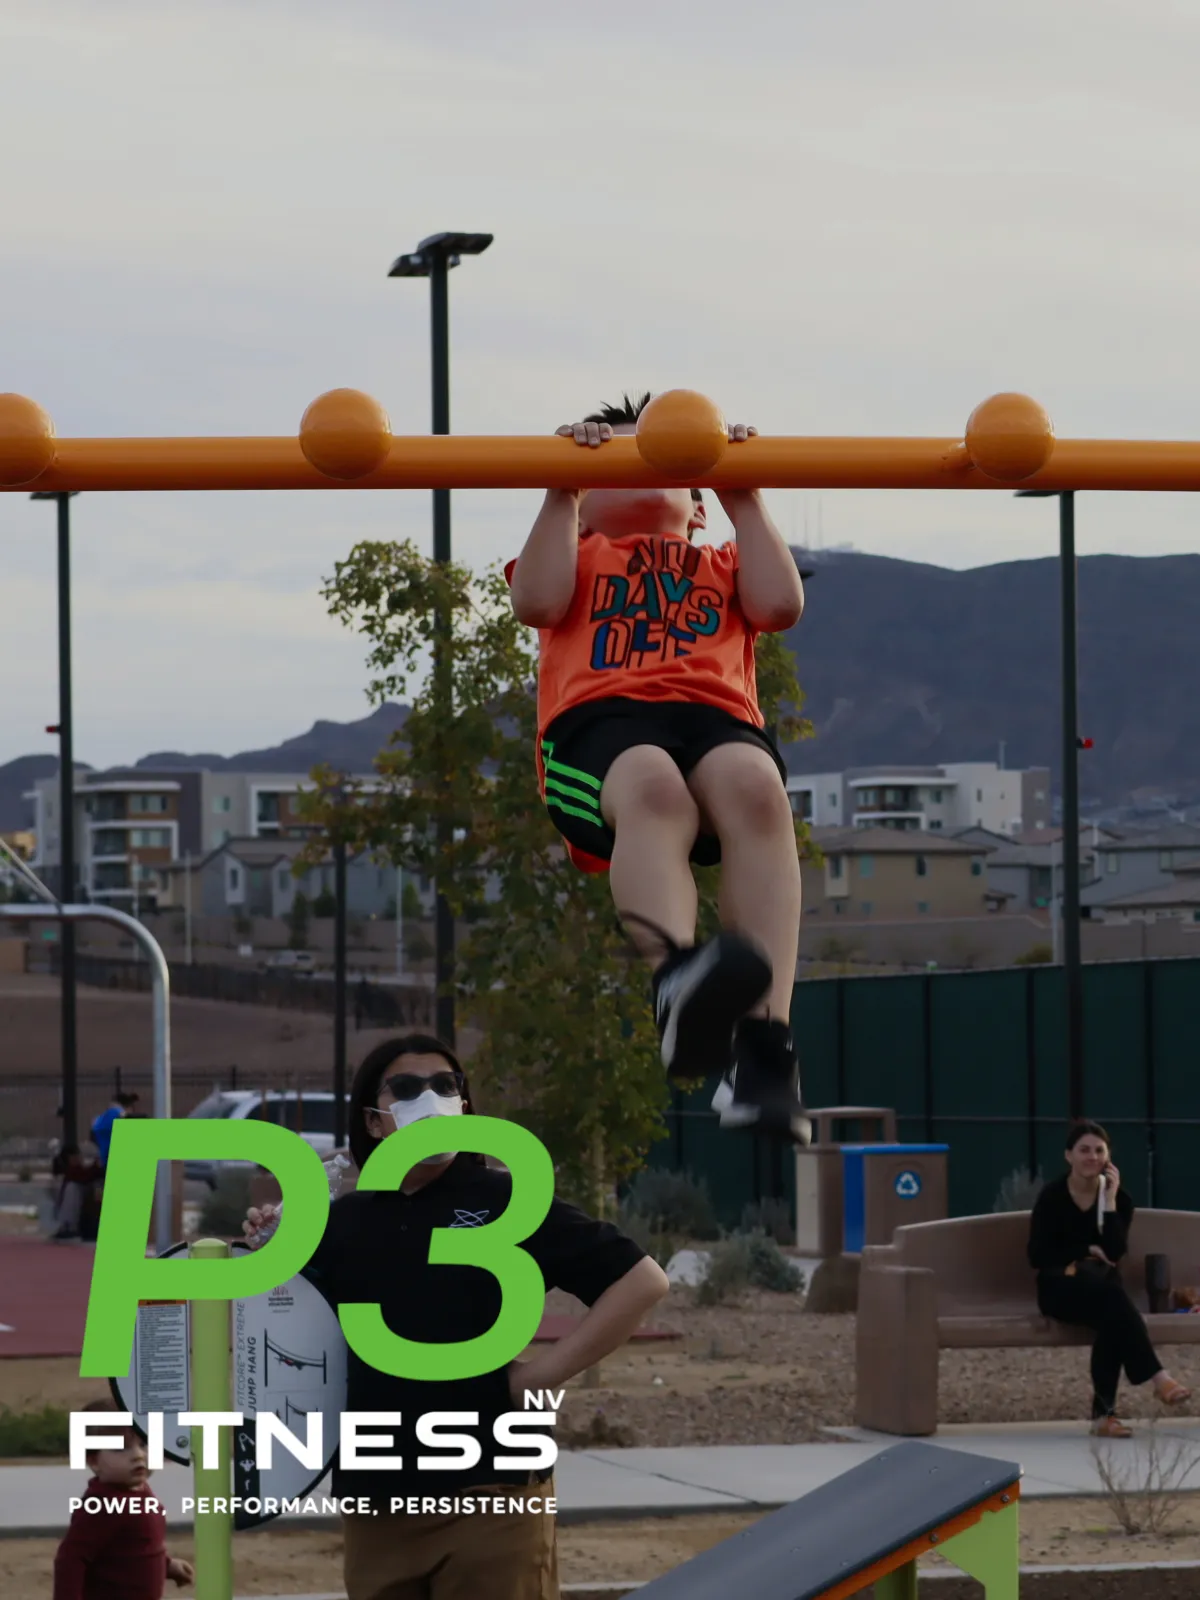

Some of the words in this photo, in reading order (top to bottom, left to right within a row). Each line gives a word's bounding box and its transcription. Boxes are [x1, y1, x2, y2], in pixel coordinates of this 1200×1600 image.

[590, 570, 723, 636] DAYS
[589, 616, 698, 671] OFF
[247, 1335, 257, 1374] HANG
[247, 1377, 257, 1413] JUMP
